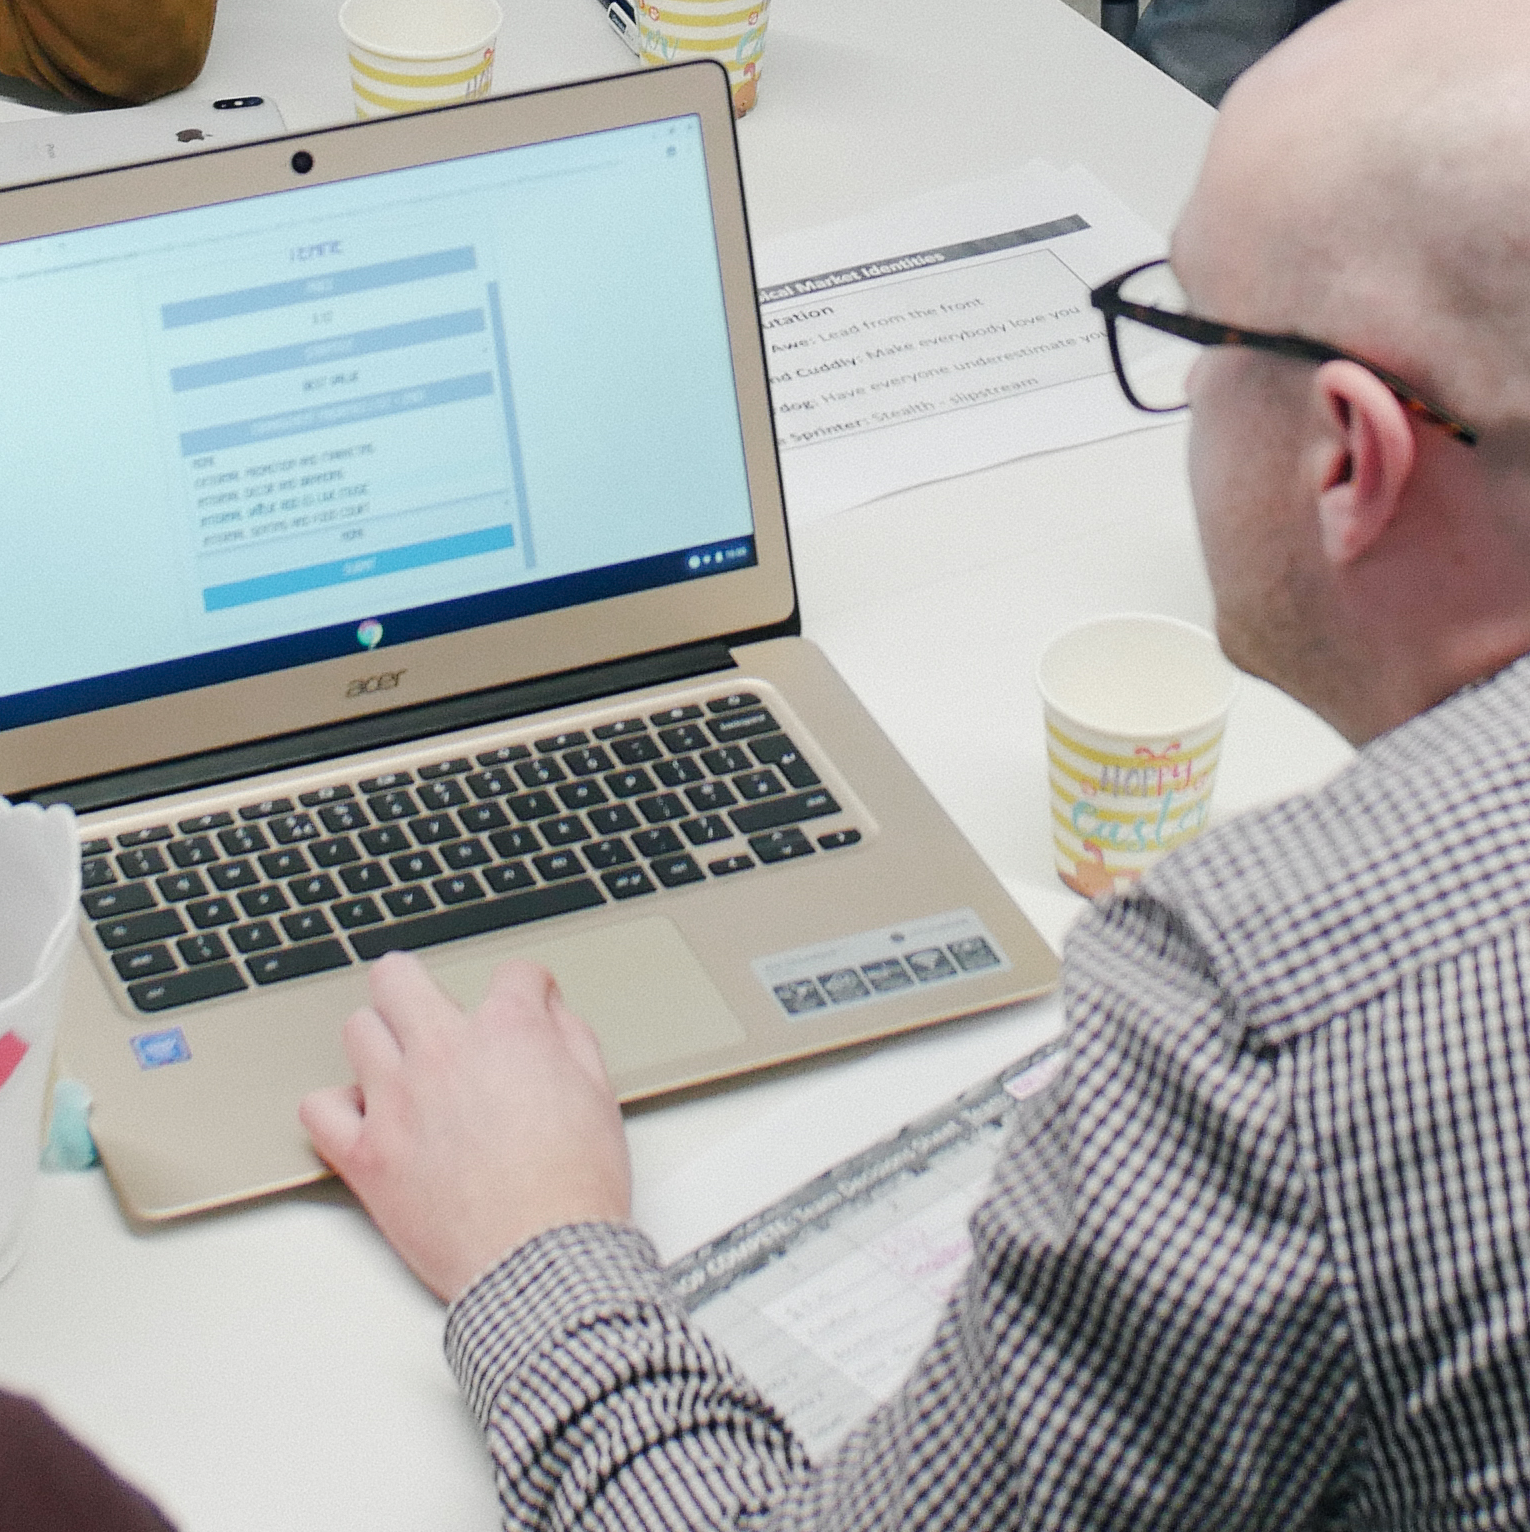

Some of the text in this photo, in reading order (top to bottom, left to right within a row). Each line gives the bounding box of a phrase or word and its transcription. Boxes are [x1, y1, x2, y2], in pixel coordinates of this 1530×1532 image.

[795, 269, 863, 294] Market
[863, 251, 946, 279] Identities
[761, 305, 835, 329] utation
[819, 324, 859, 342] Lead
[862, 315, 904, 330] from
[908, 308, 937, 319] the
[940, 297, 985, 313] front
[769, 370, 793, 384] nd
[865, 343, 915, 360] Make
[918, 323, 1007, 347] everybody
[1008, 314, 1046, 329] love
[1048, 305, 1081, 320] you
[821, 386, 867, 403] Have
[870, 366, 950, 390] everyone
[953, 337, 1077, 371] underestimate
[871, 401, 936, 422] Stealth
[949, 377, 1040, 404] slipstream
[345, 669, 407, 698] acer
